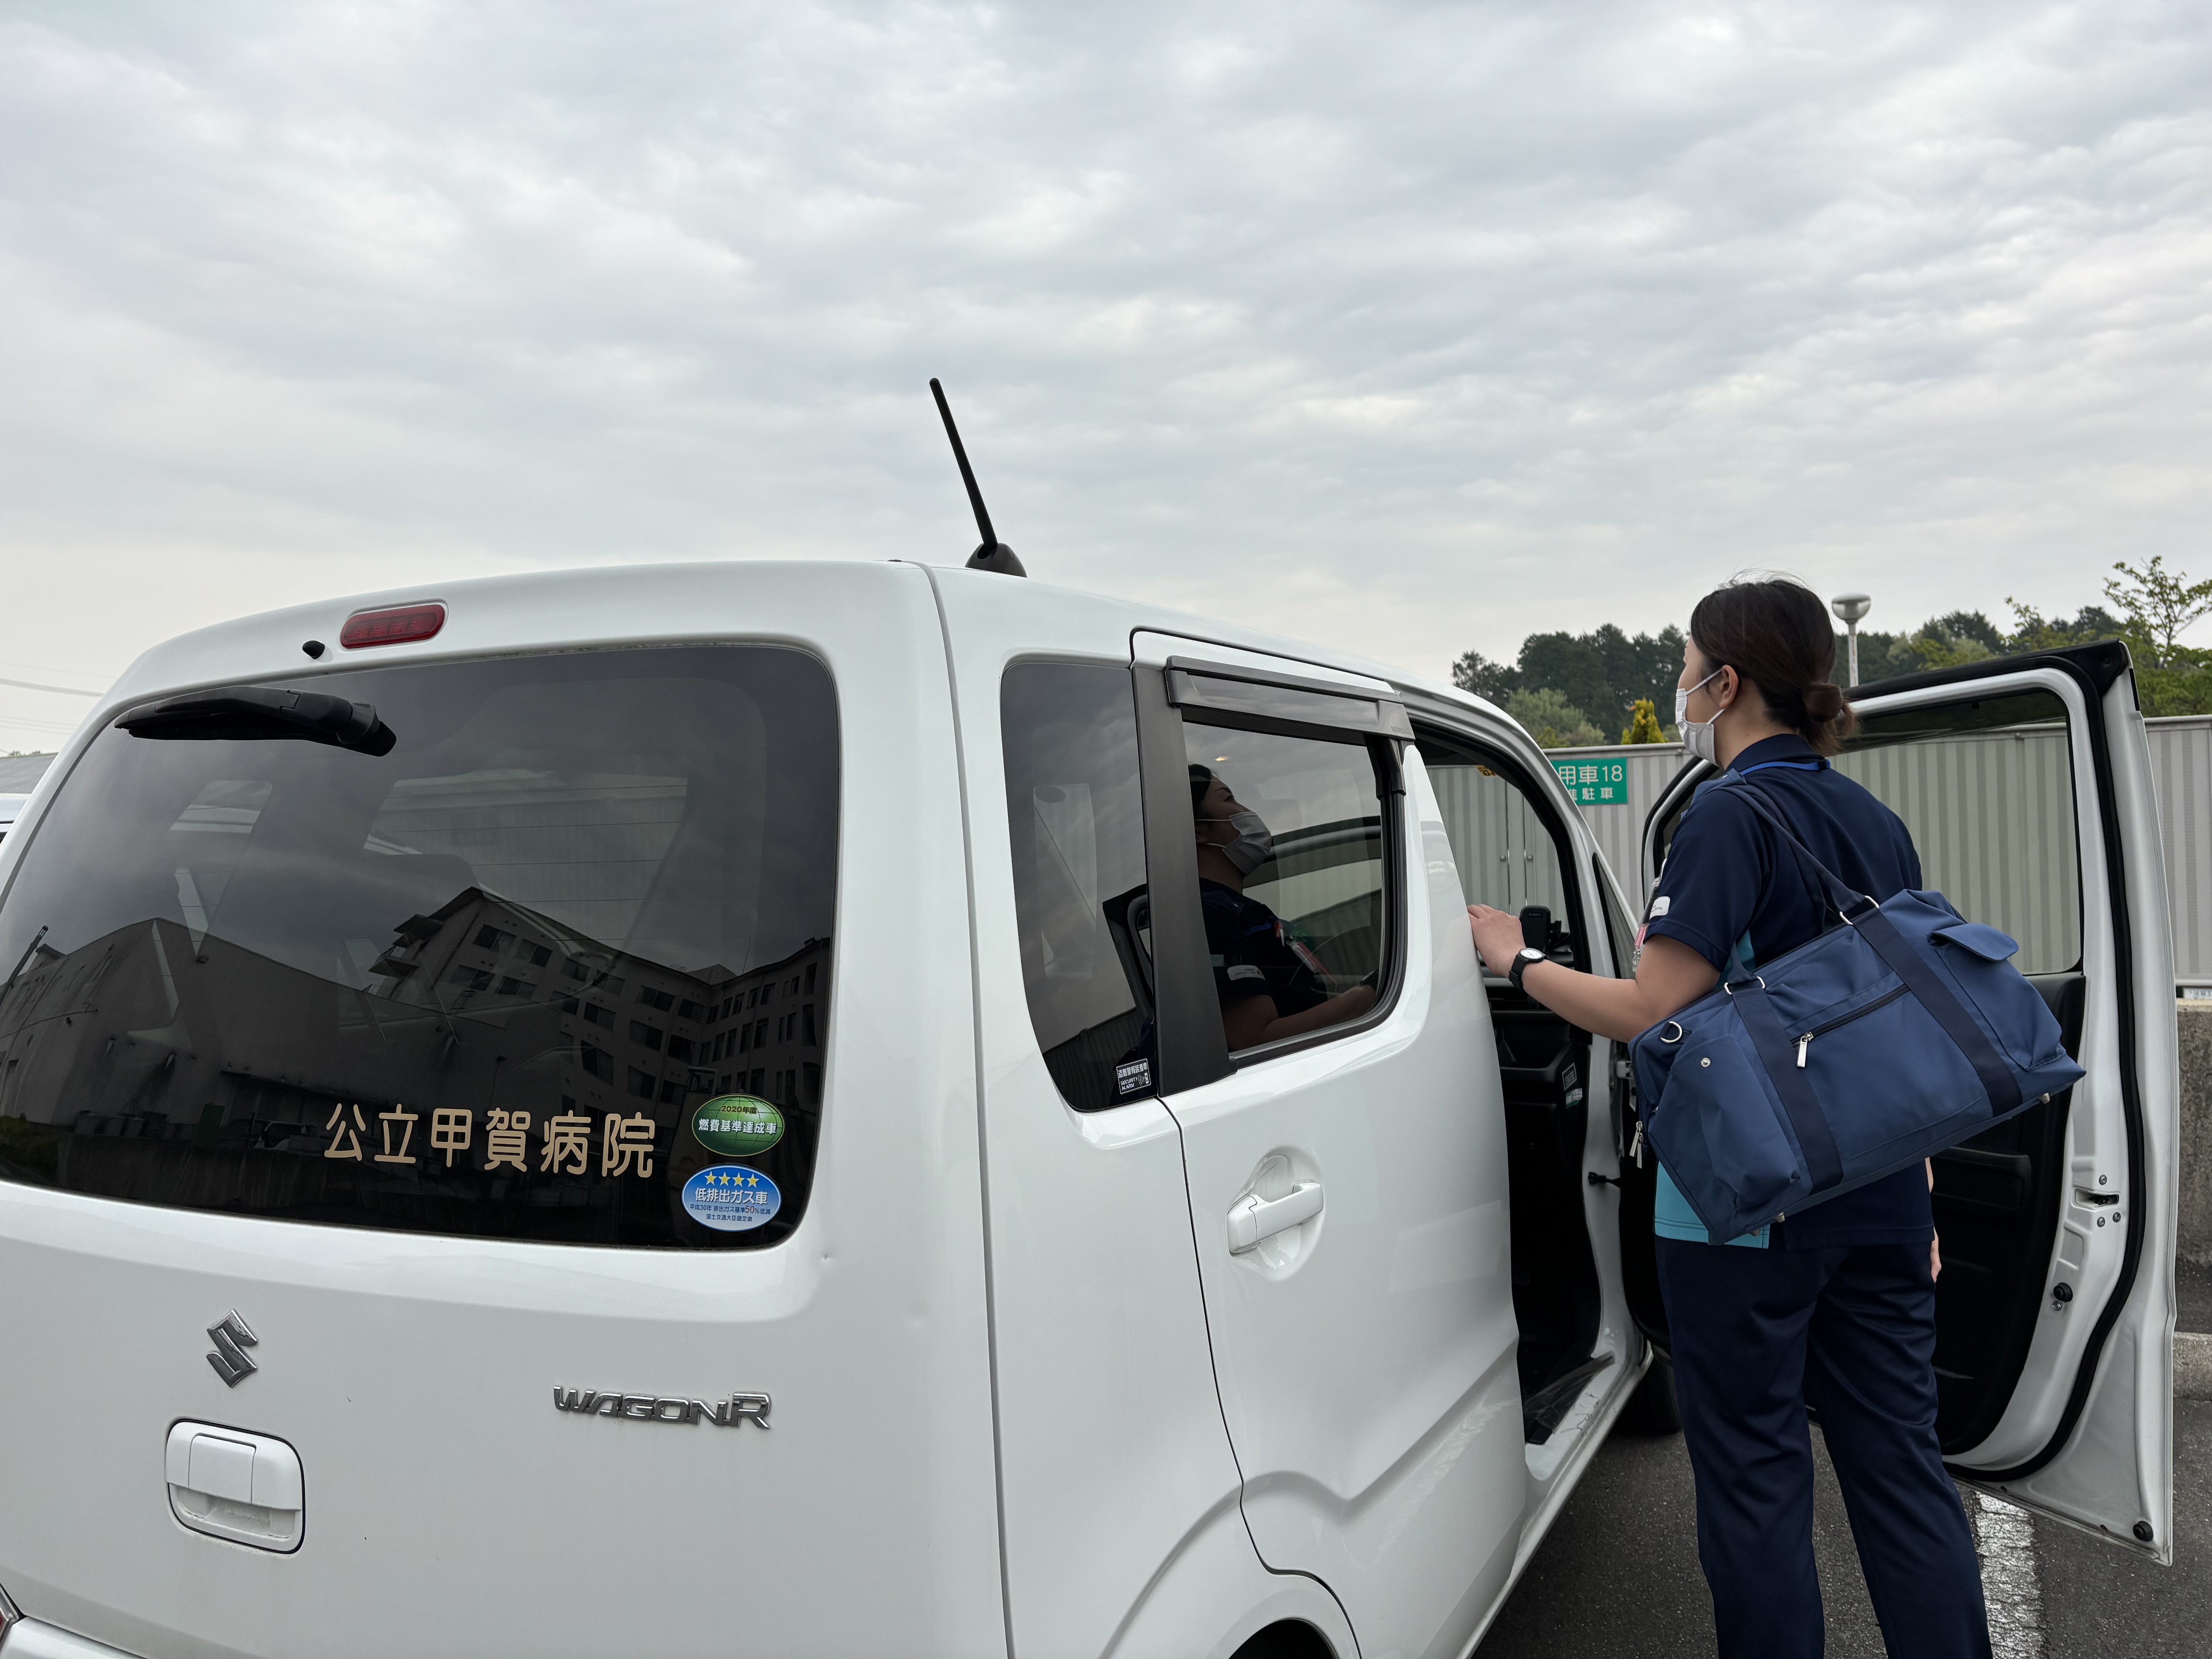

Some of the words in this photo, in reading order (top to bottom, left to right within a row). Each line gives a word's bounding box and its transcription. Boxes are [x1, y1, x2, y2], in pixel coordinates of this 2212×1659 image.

[1120, 1077, 1138, 1085] SECURITY
[721, 1106, 757, 1114] 2020年度
[698, 1118, 777, 1135] 燃費基準達成車
[324, 1103, 655, 1178] 公立甲賀病院
[695, 1187, 768, 1205] 低排出ガス車
